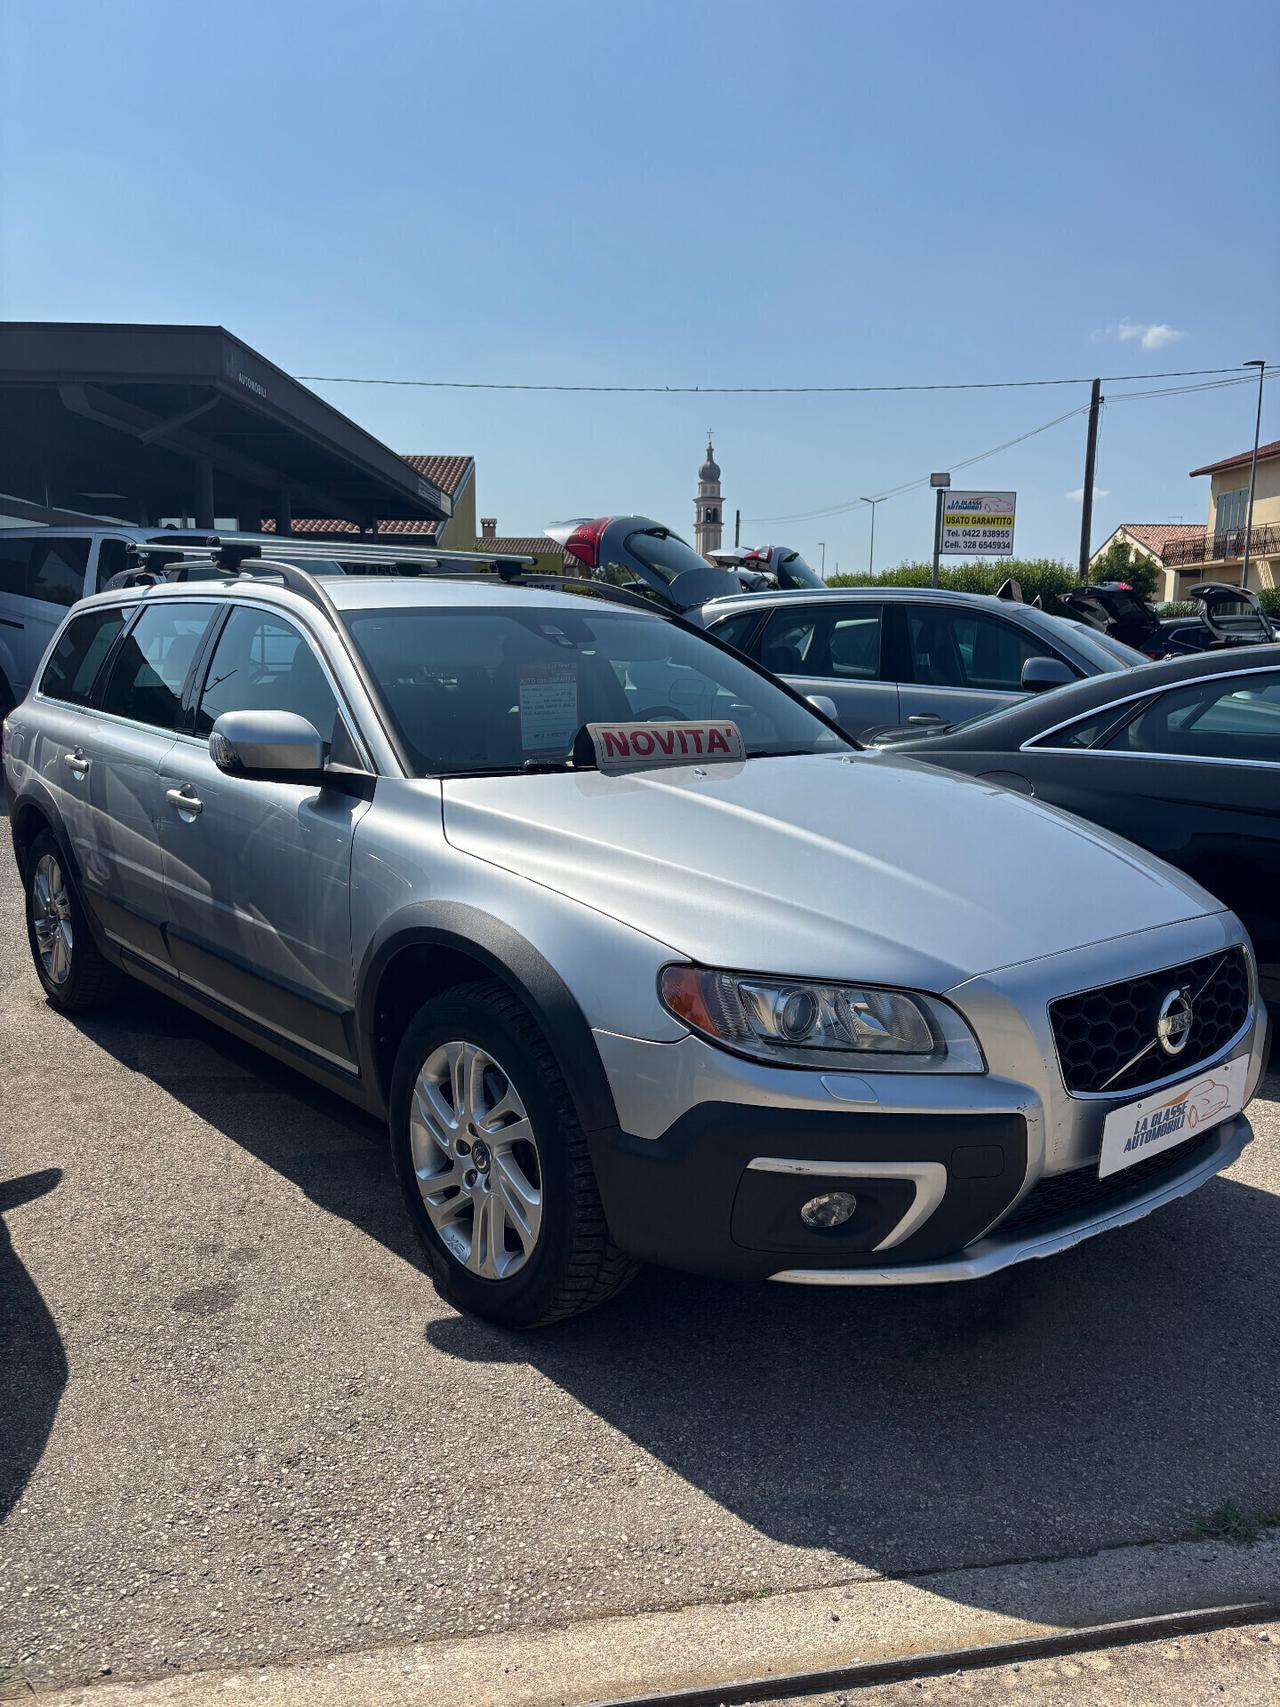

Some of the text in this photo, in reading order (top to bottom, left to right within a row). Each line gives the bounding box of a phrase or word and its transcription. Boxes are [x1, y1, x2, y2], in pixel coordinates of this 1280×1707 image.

[238, 372, 267, 398] AUTOMOBILI
[946, 516, 1012, 525] USATO GARANTITO
[982, 530, 1009, 538] 838955
[963, 541, 977, 549] 328
[979, 541, 1010, 549] 6545934
[601, 728, 732, 757] NOVITA'
[1123, 1114, 1186, 1154] AUTOMOBILI
[1133, 1117, 1148, 1135] LA
